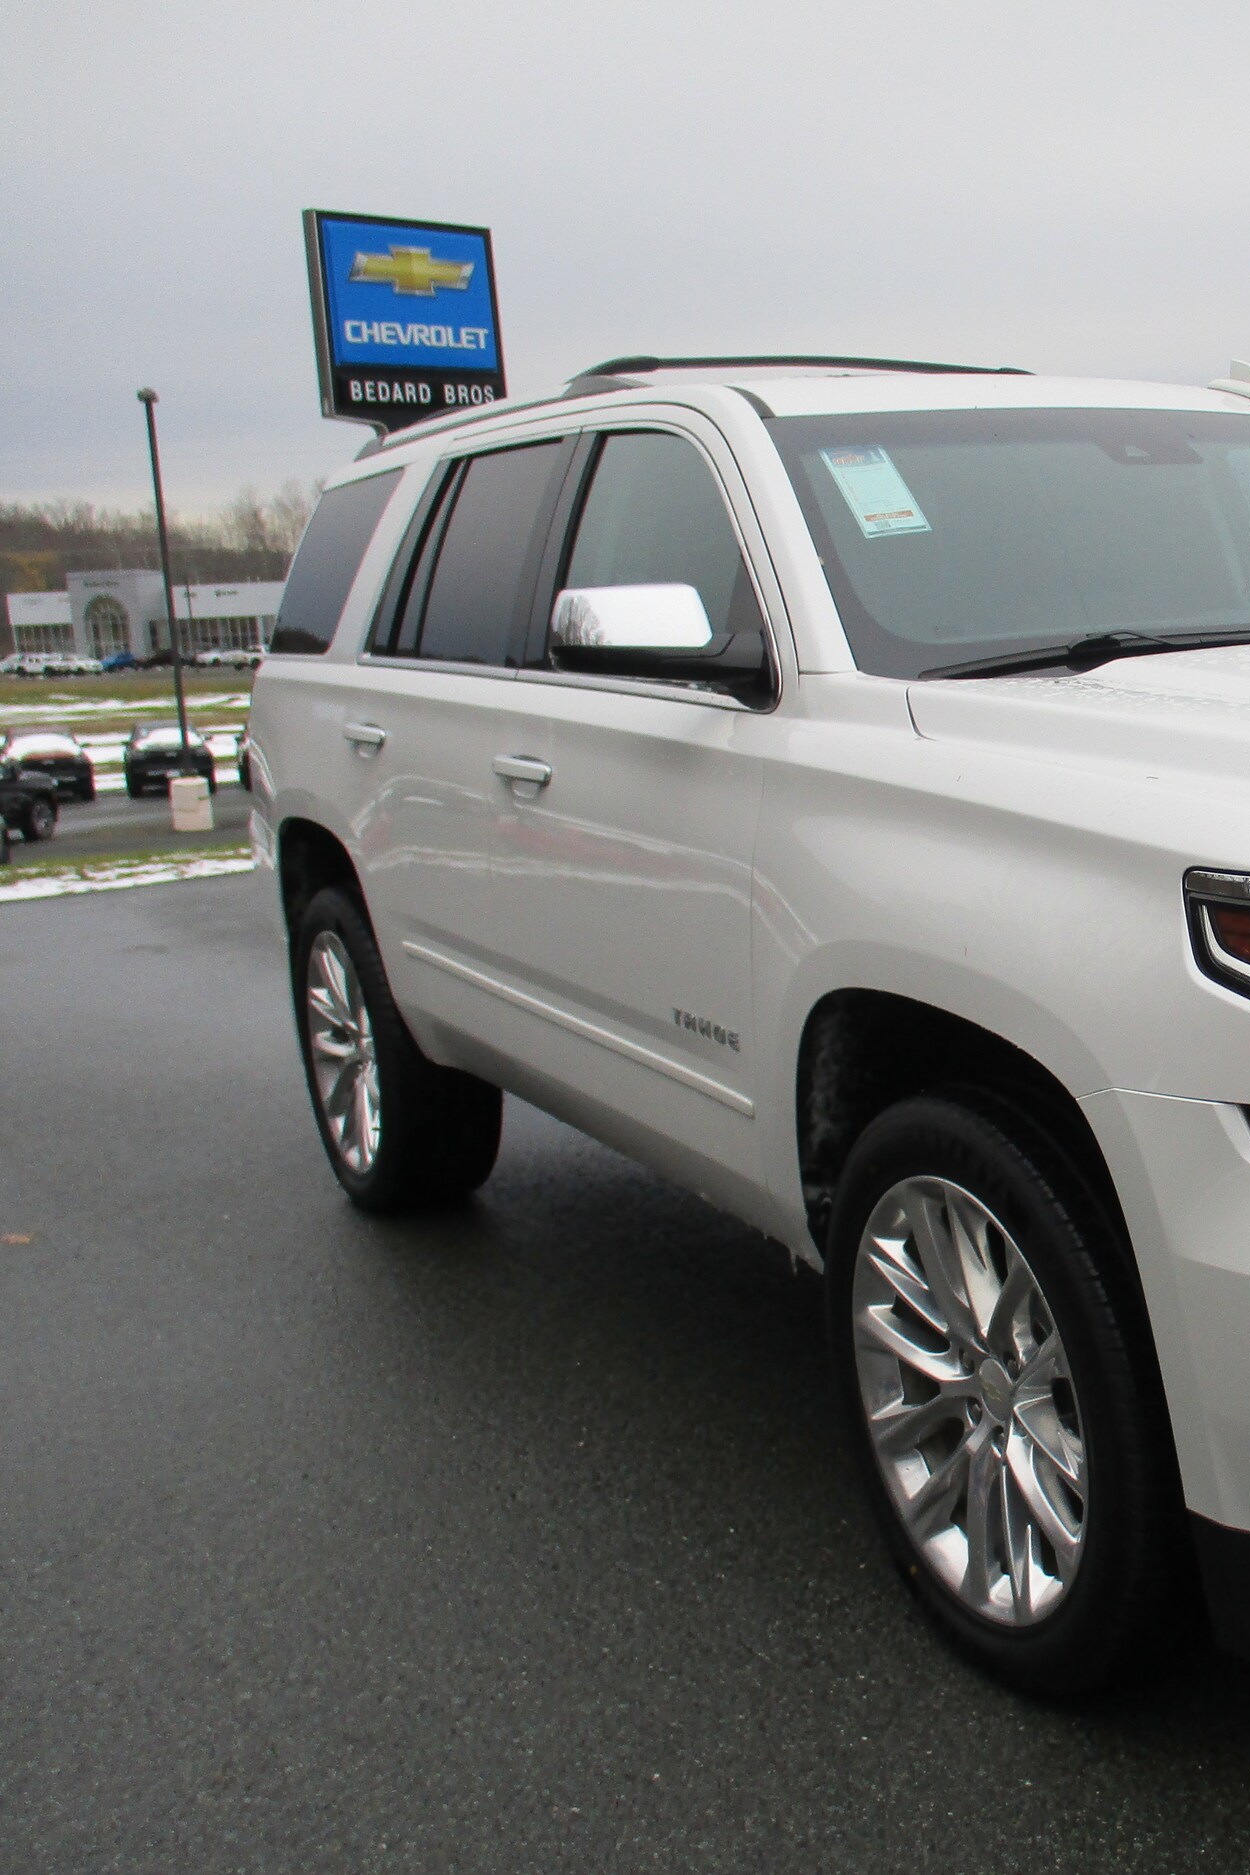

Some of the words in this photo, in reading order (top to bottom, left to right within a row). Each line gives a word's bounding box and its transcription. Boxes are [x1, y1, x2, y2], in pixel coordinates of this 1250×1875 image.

[343, 319, 489, 350] CHEVROLET
[350, 379, 432, 404] BEDARD
[443, 383, 495, 405] BROS
[672, 1007, 741, 1053] TAHOE
